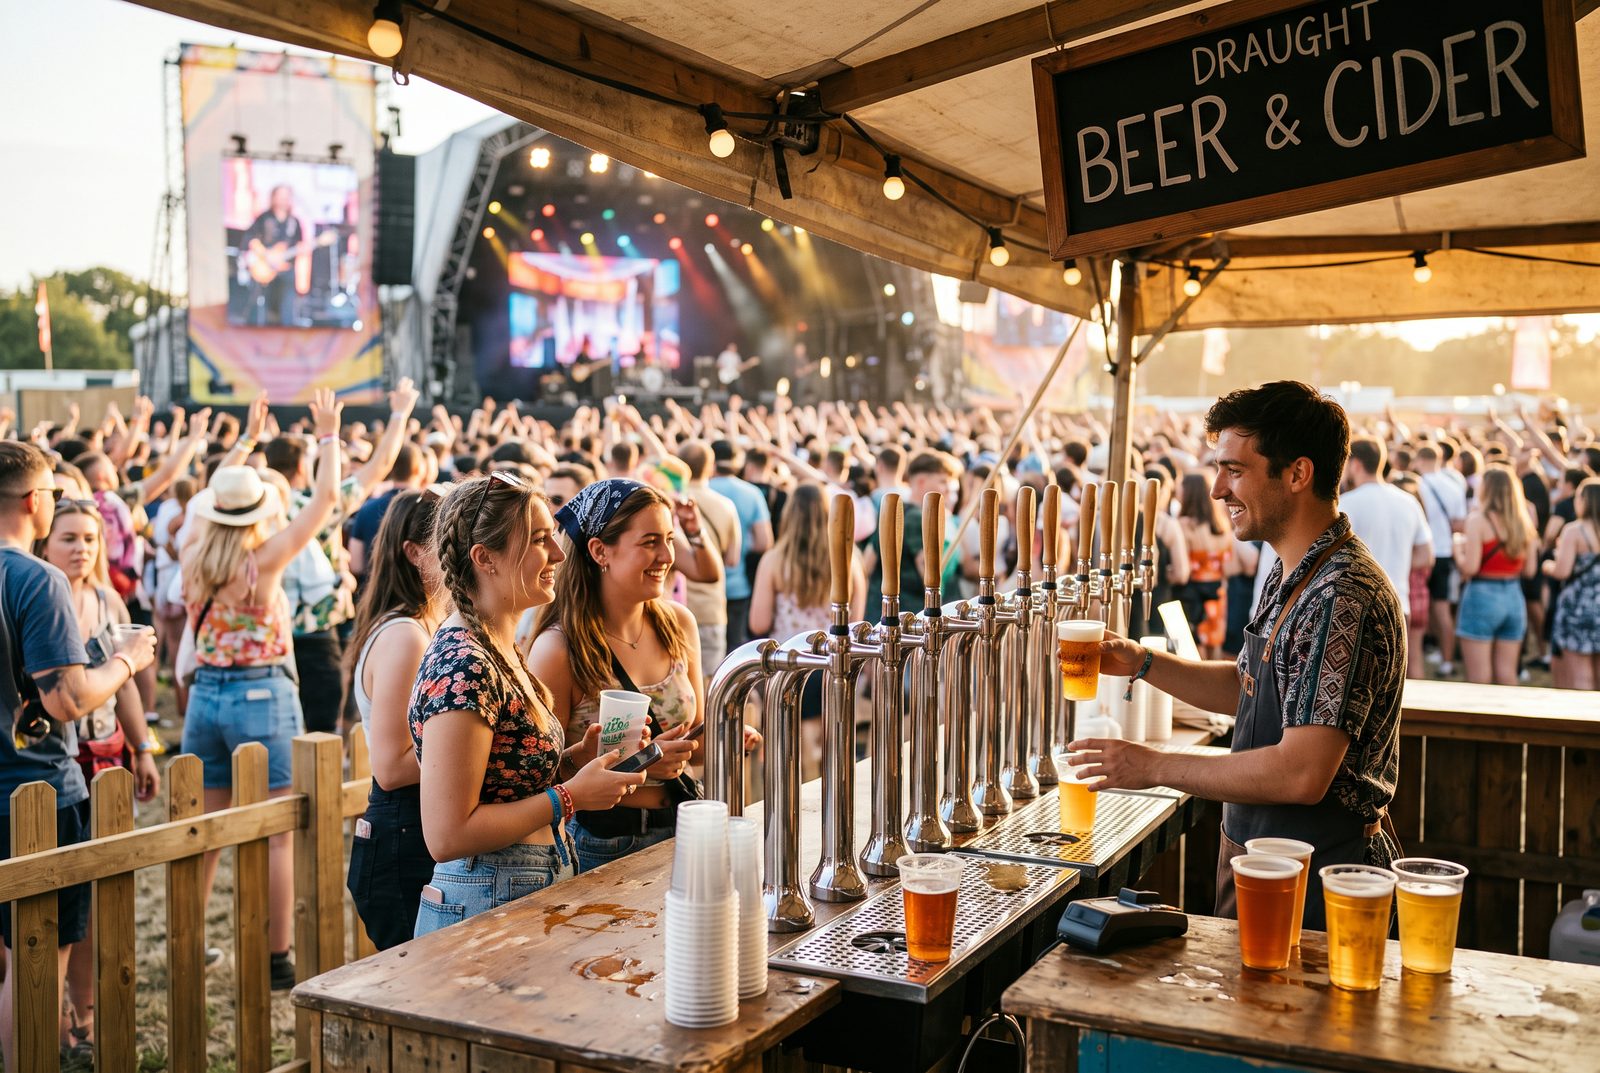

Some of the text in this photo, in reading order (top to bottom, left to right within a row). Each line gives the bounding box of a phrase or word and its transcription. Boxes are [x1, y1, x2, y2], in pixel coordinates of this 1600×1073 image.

[1191, 0, 1379, 86] DRAUGHT
[1076, 19, 1539, 203] BEER & CIDER
